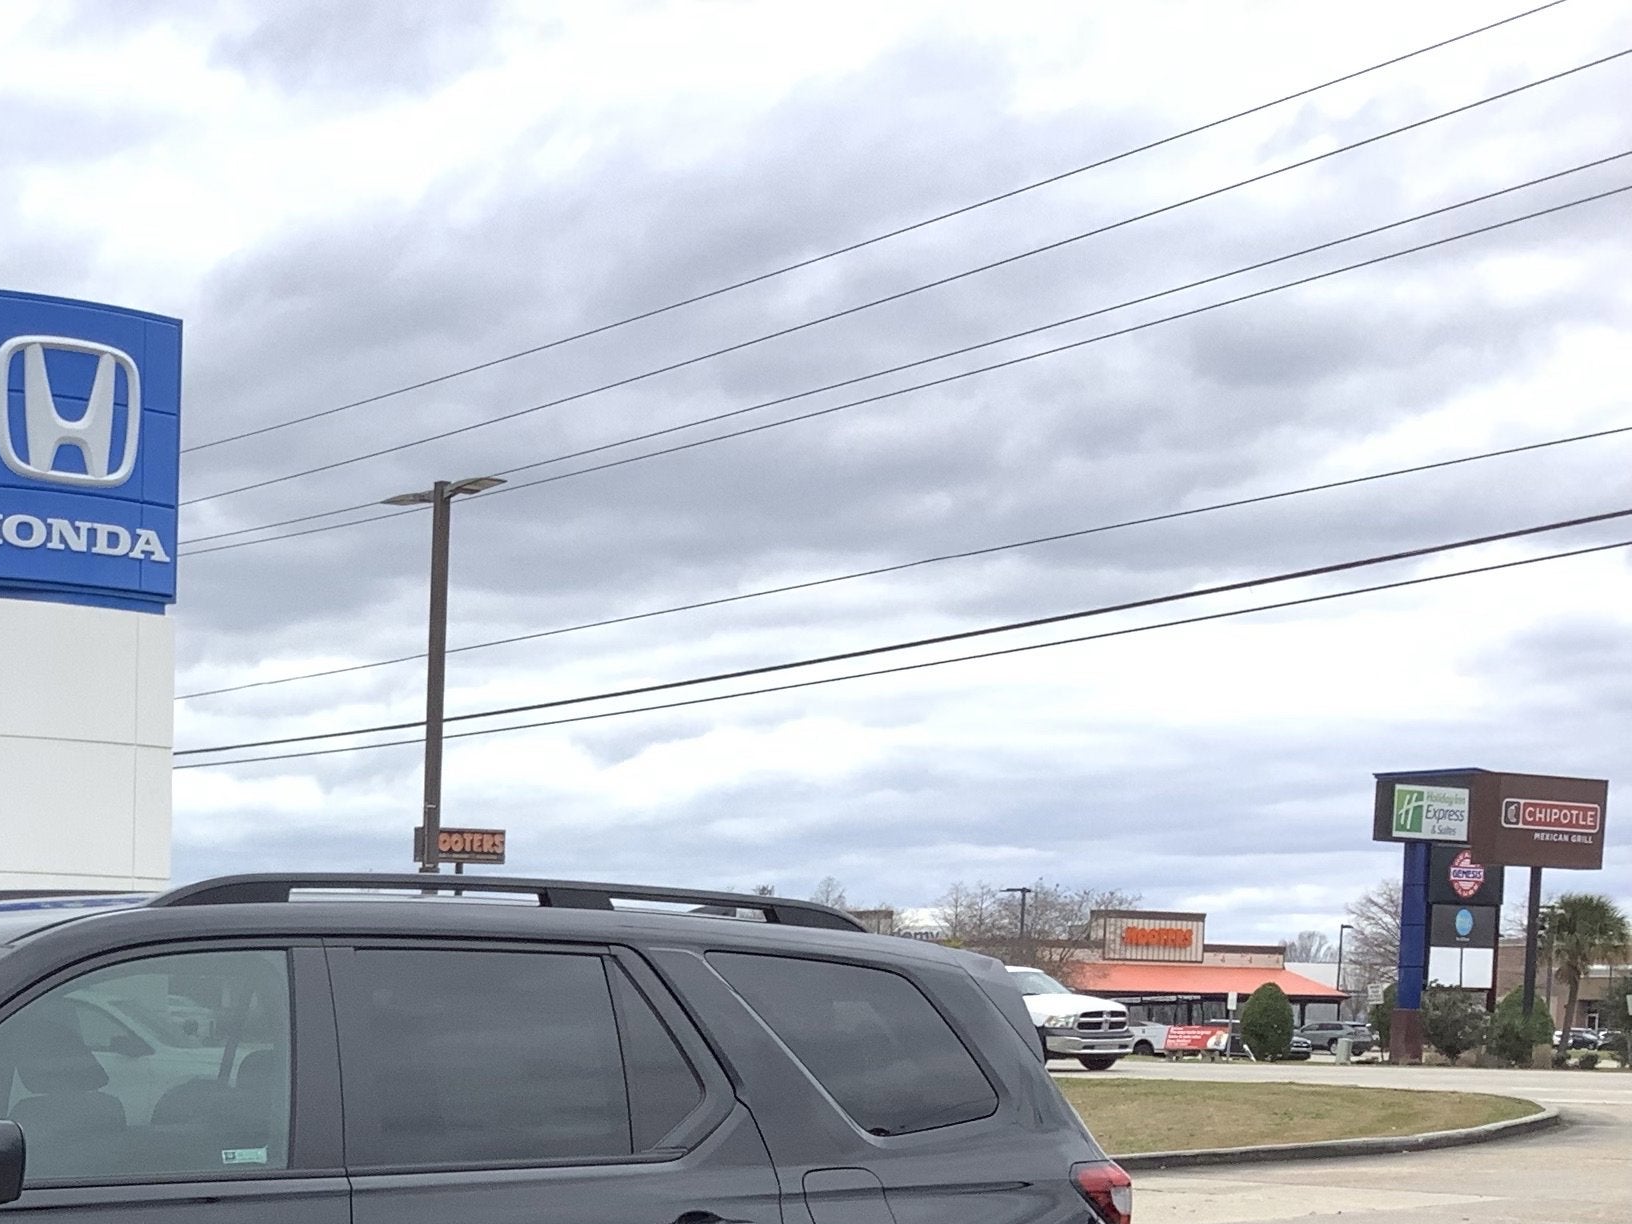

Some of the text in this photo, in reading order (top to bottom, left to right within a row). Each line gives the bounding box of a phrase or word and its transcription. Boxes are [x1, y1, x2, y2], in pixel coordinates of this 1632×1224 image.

[1427, 792, 1466, 806] Holiday Inn
[1425, 804, 1466, 824] Express
[1524, 807, 1596, 826] CHIPOTLE
[1437, 825, 1457, 836] Suites
[1533, 833, 1593, 844] MEXICAN GRILL
[439, 832, 503, 854] OOTERS
[1452, 869, 1483, 880] GENESIS
[1123, 927, 1194, 949] HOOTERS
